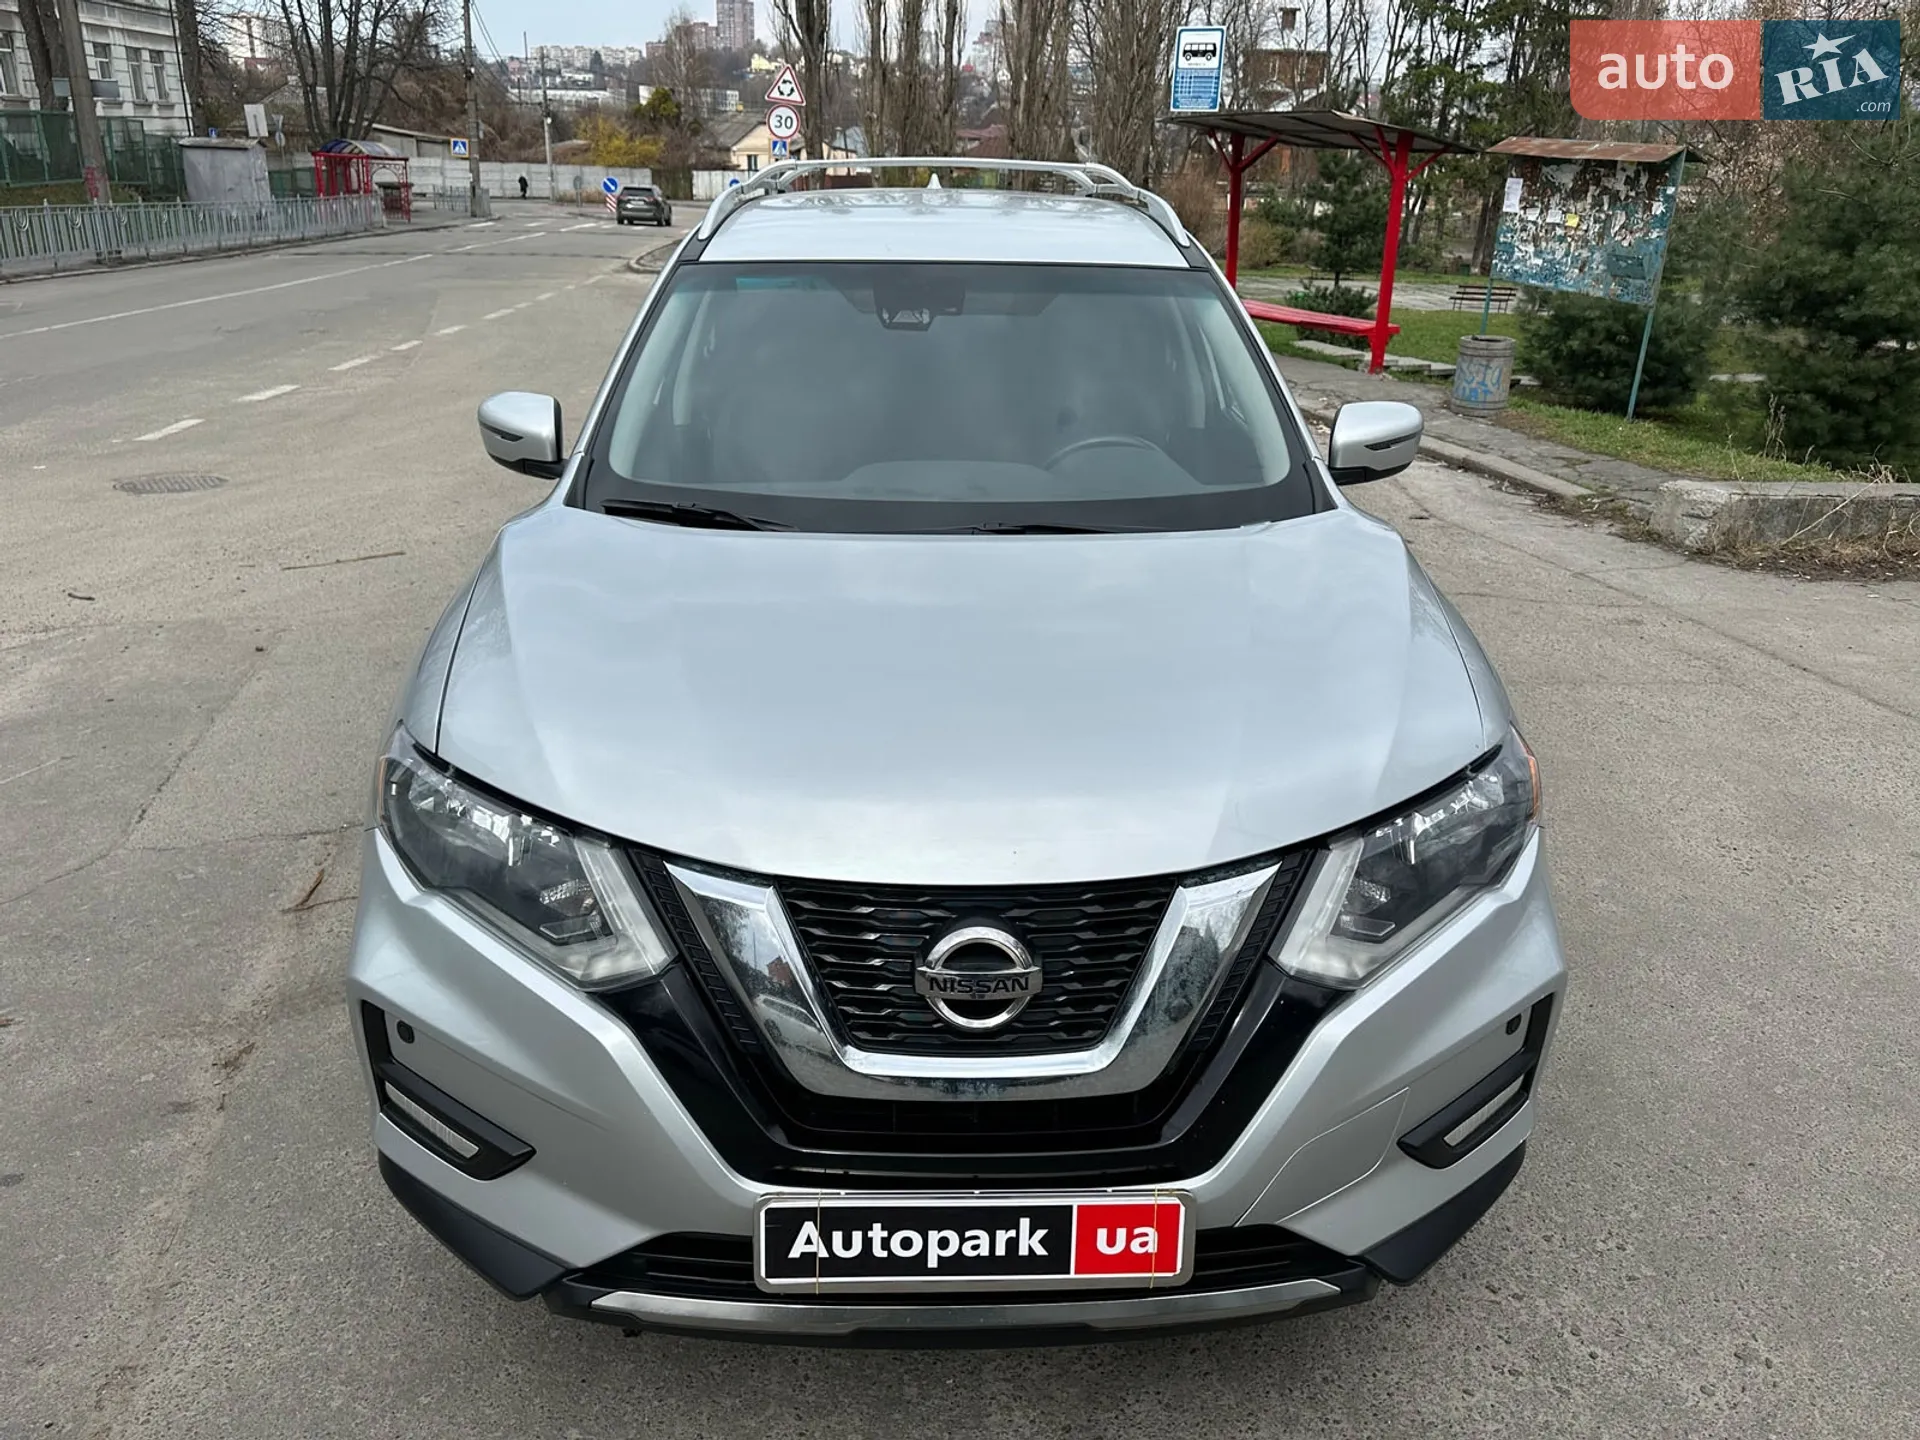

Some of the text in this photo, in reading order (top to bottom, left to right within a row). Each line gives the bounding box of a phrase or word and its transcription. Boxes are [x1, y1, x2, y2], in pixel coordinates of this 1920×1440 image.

[774, 114, 794, 130] 30
[929, 977, 1029, 993] NISSAN
[787, 1217, 1158, 1269] Autopark ua
